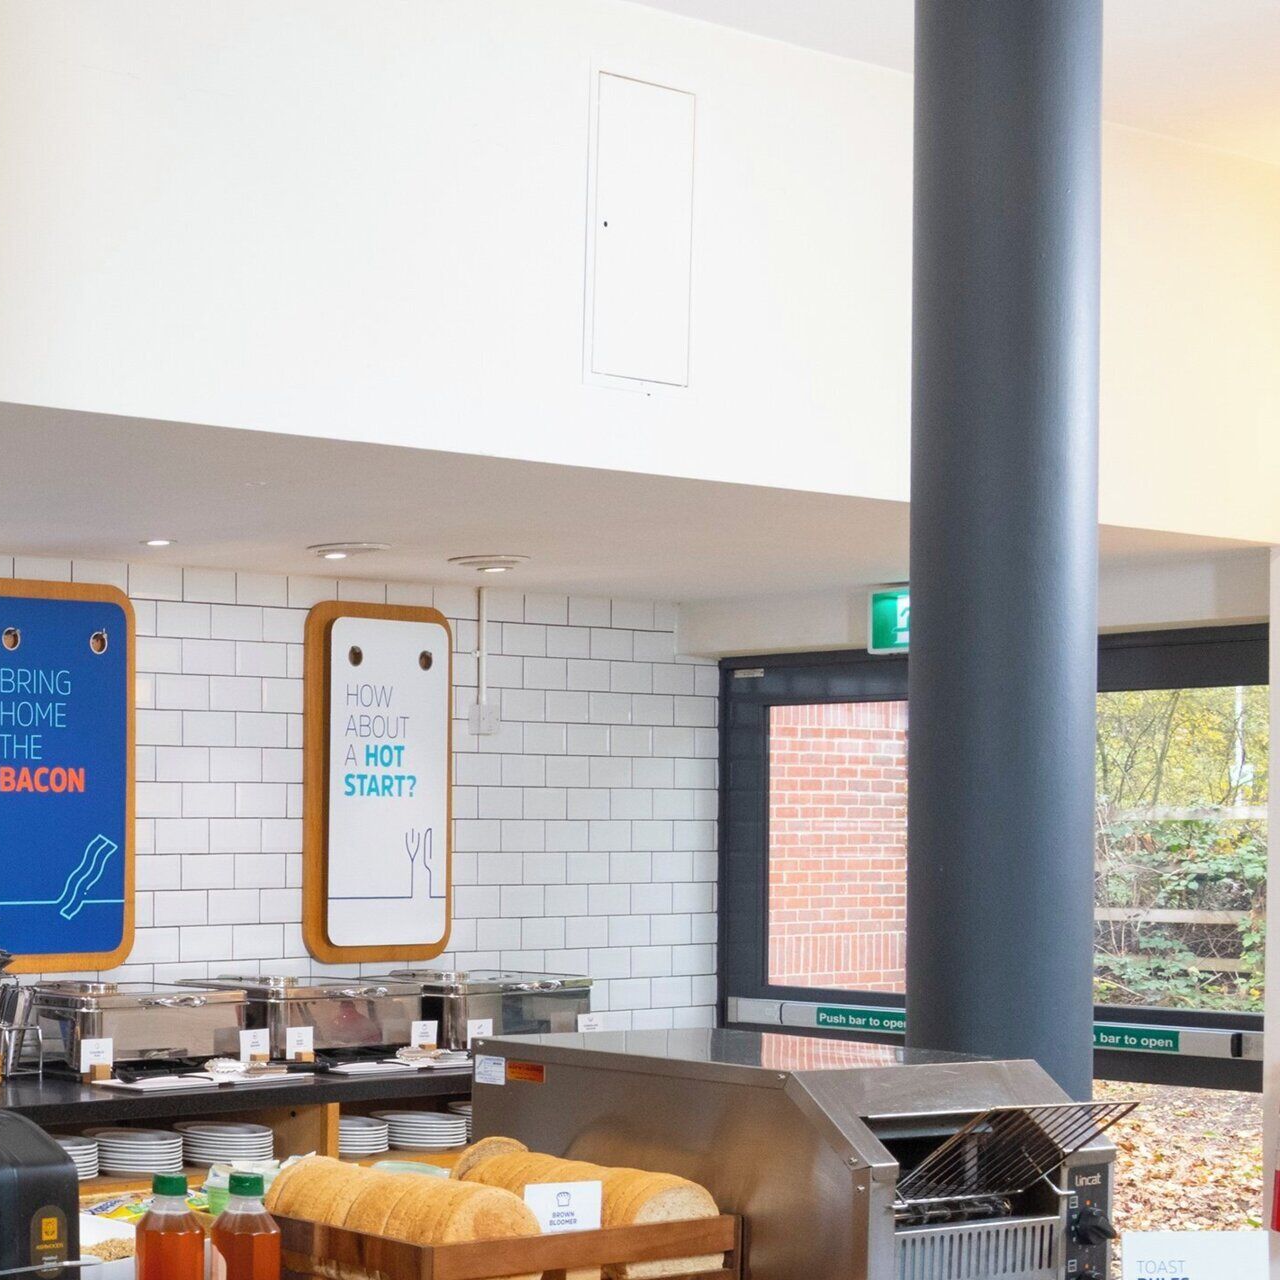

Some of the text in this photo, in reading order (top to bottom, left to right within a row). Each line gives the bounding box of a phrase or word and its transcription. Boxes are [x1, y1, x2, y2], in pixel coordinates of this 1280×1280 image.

[0, 668, 71, 695] BRING
[346, 684, 393, 708] HOW
[0, 701, 67, 728] HOME
[344, 714, 410, 739] ABOUT
[0, 734, 42, 760] THE
[344, 743, 405, 768] A HOT
[0, 766, 85, 793] BACON
[344, 773, 417, 798] START?
[819, 1012, 906, 1029] Push bar to ope
[1100, 1032, 1121, 1044] bar
[1124, 1034, 1137, 1045] to
[1141, 1037, 1173, 1049] open
[549, 1218, 577, 1226] BLOOMER
[552, 1211, 575, 1219] BROWN
[1136, 1260, 1185, 1274] TOAST
